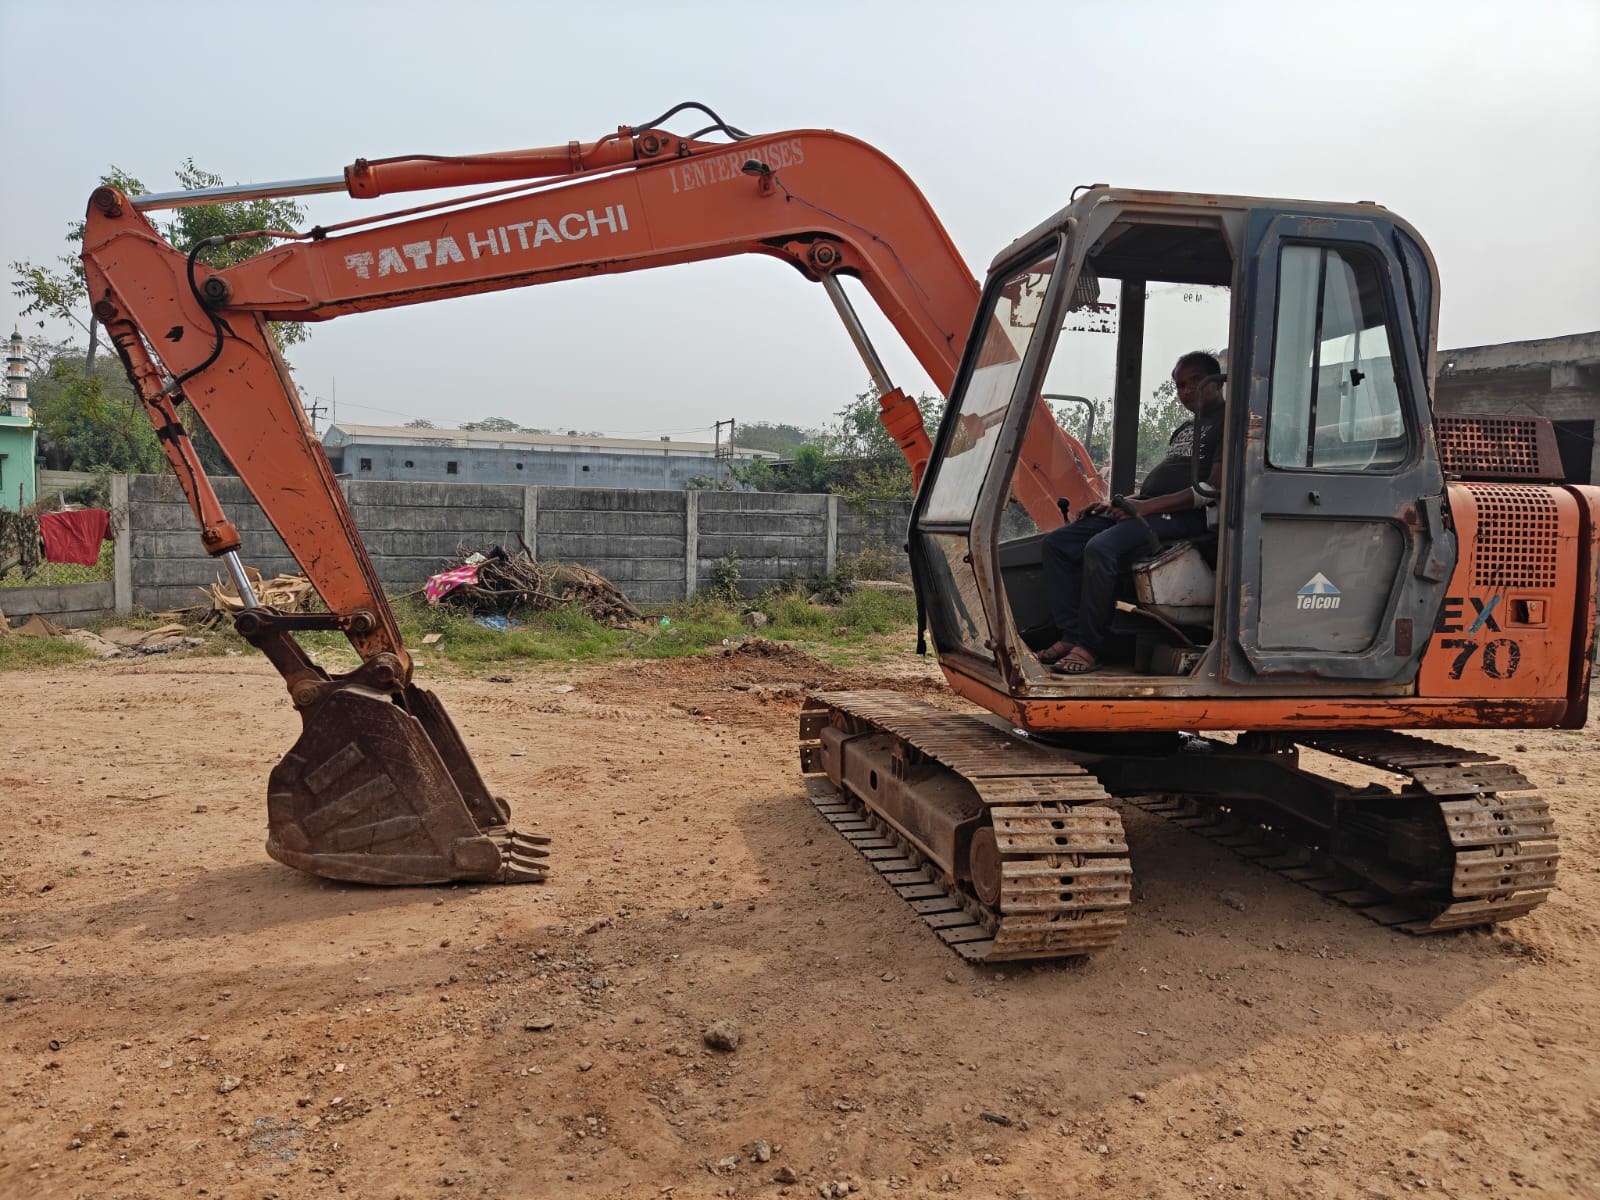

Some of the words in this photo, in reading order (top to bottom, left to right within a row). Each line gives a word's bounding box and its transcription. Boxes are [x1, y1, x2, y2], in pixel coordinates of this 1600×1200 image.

[344, 237, 466, 280] TATA
[467, 204, 629, 260] HITACHI
[1296, 595, 1341, 610] Telcon
[1434, 594, 1502, 636] EX
[1441, 638, 1521, 680] 70
